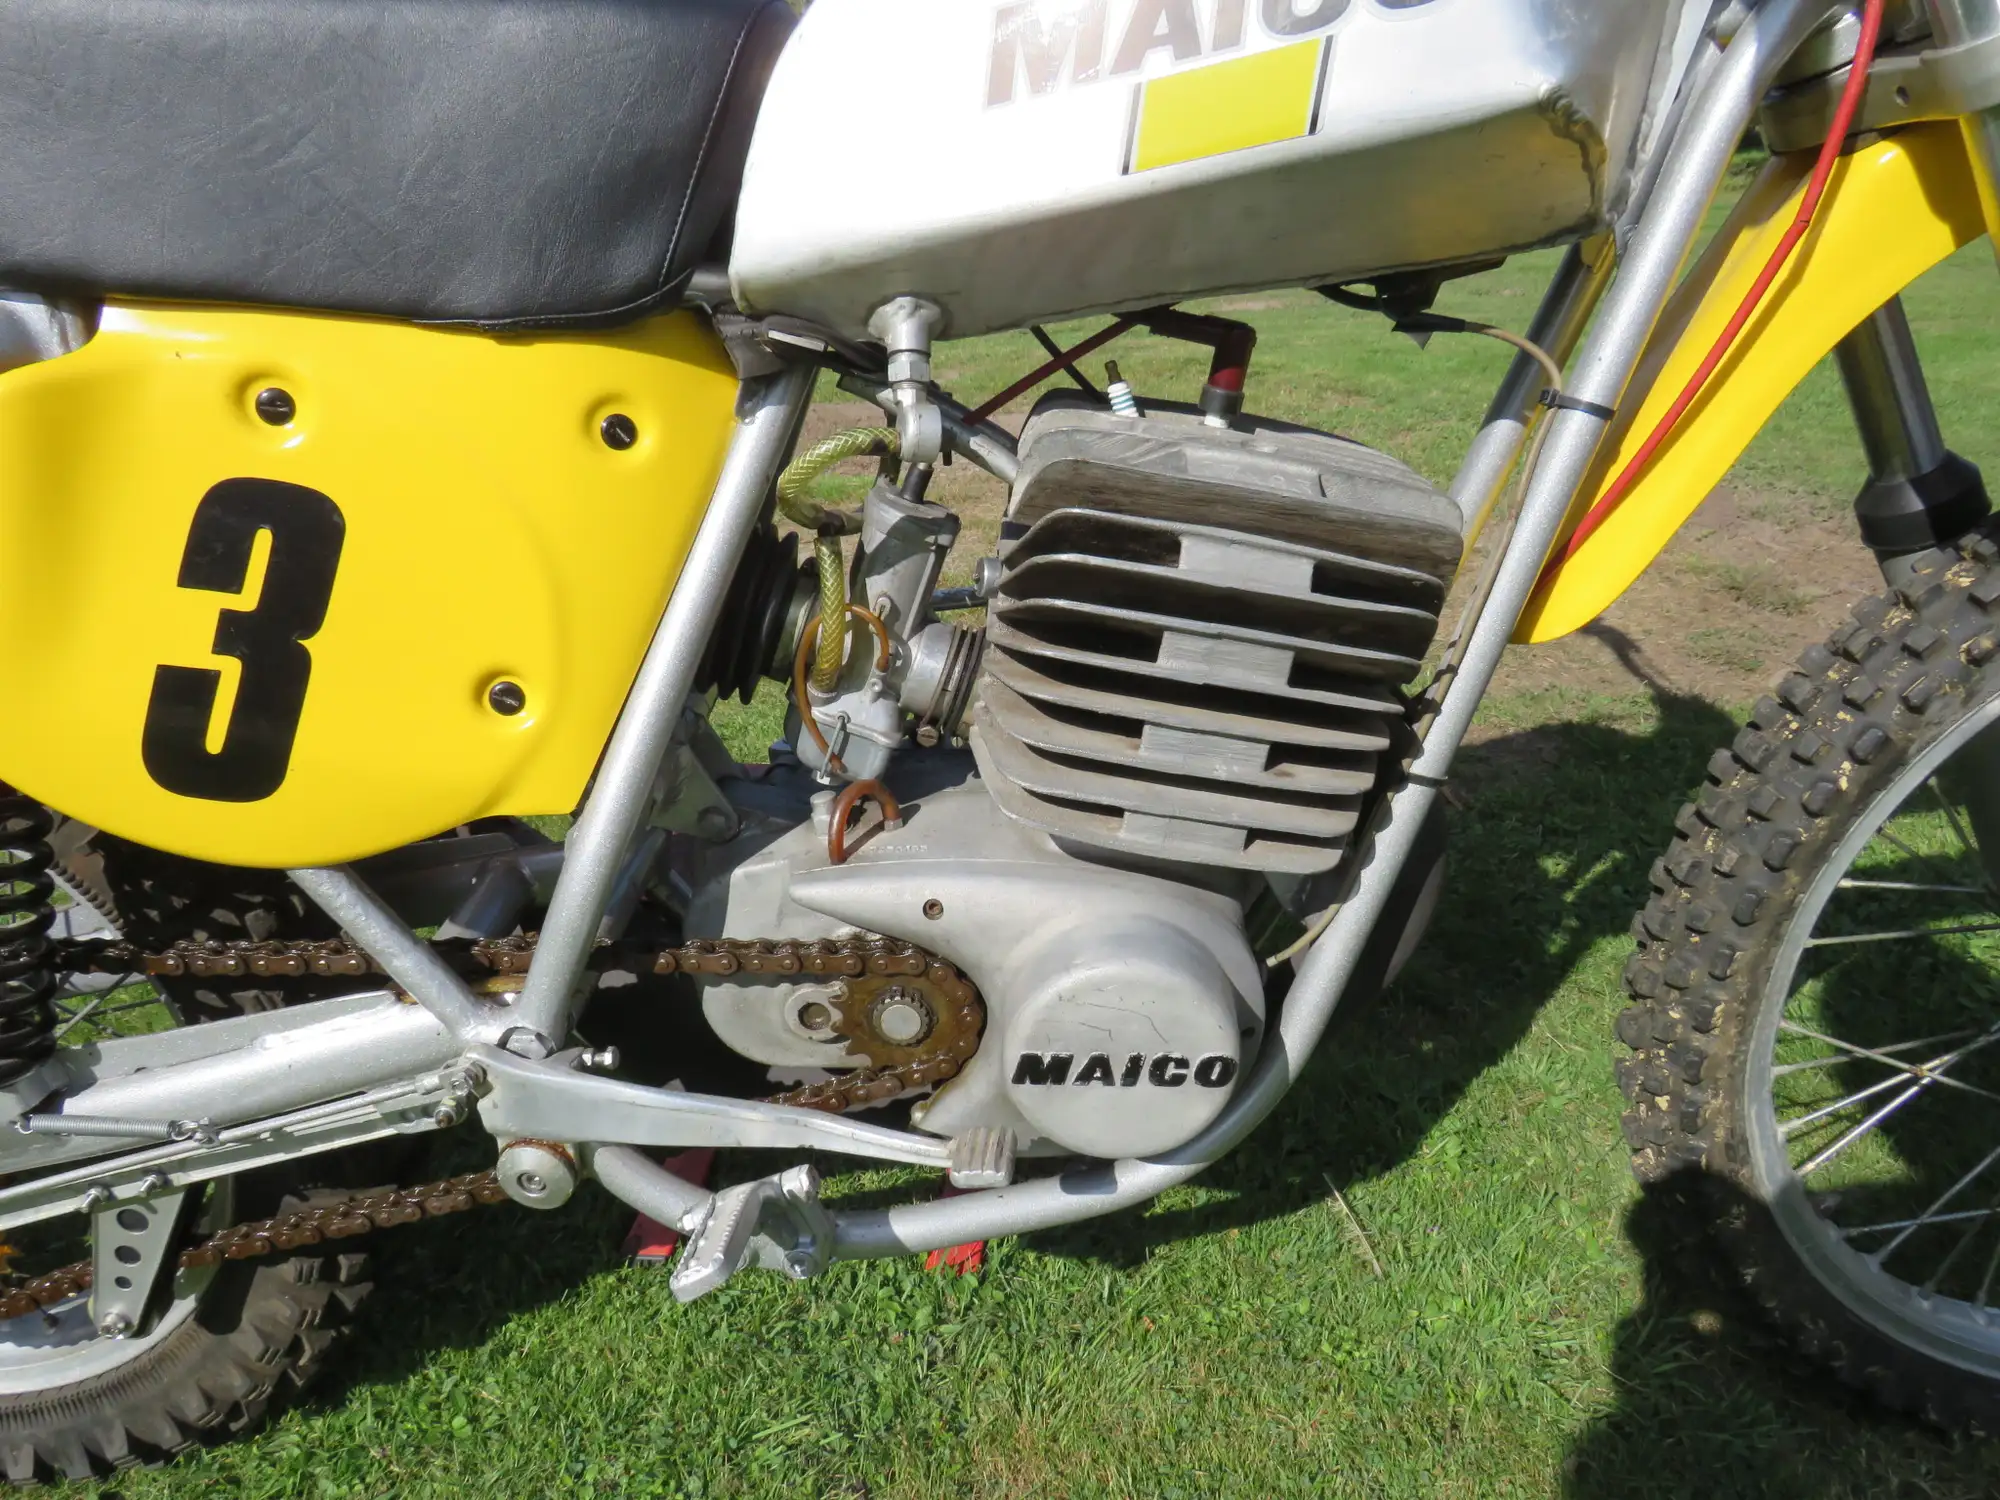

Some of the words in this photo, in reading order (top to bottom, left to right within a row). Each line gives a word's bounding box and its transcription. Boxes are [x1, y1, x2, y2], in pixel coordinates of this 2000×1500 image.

[986, 0, 1443, 107] MAI
[141, 477, 346, 803] 3
[1011, 1052, 1239, 1088] MAICO
